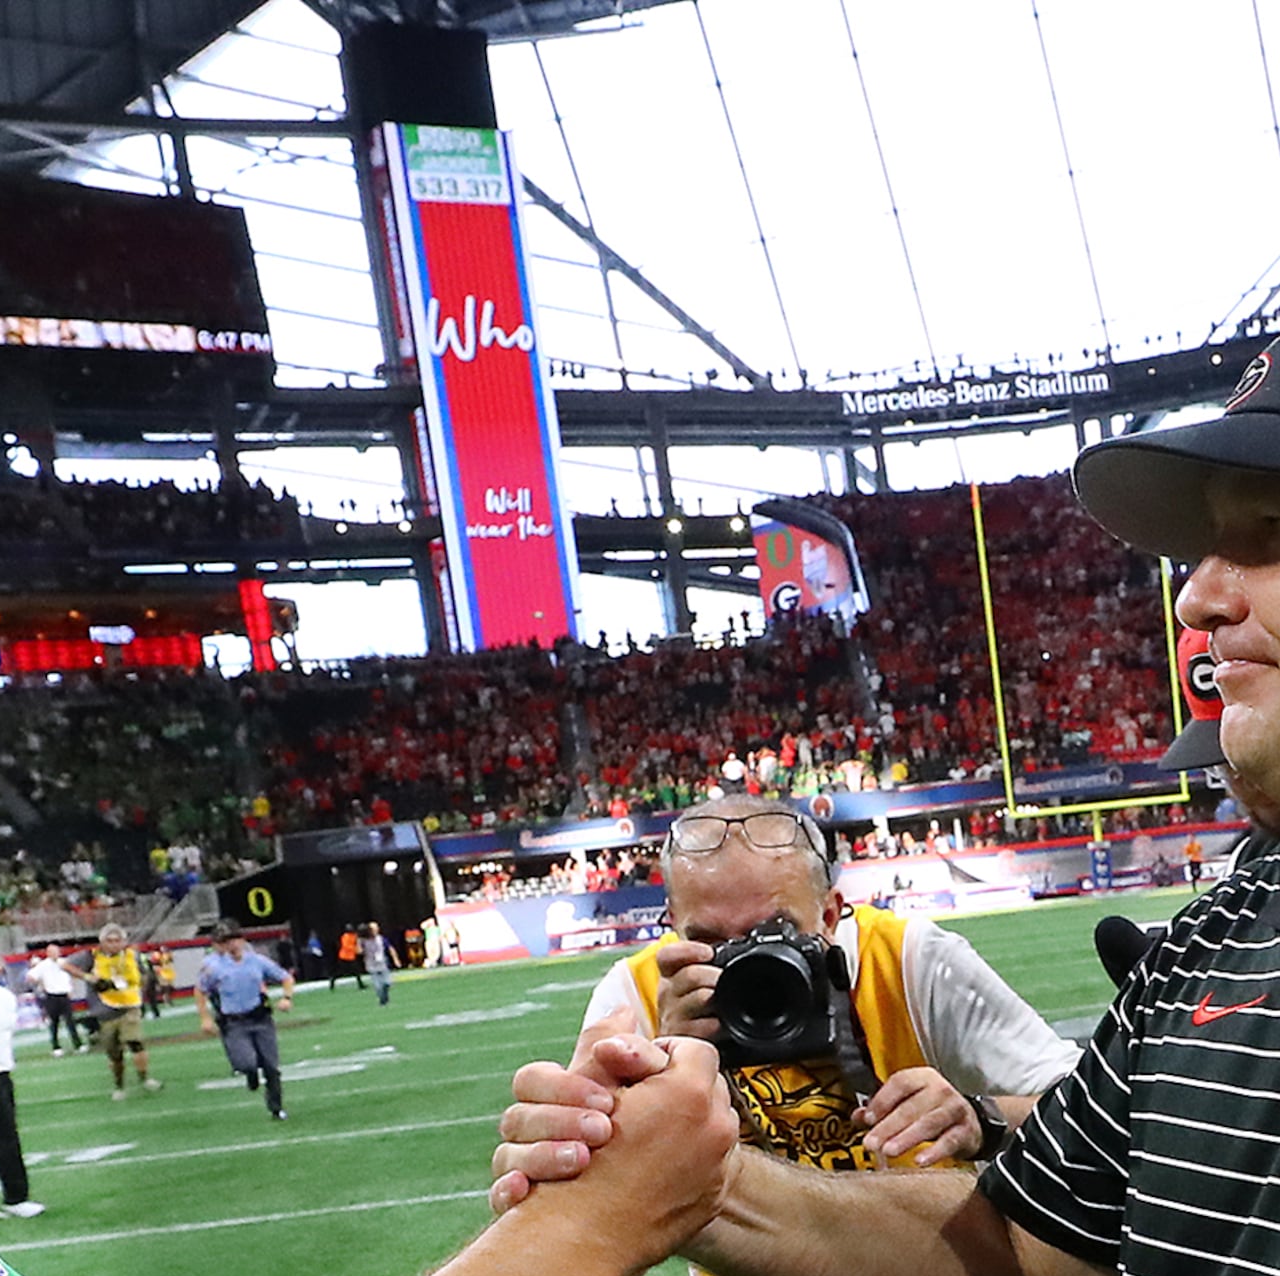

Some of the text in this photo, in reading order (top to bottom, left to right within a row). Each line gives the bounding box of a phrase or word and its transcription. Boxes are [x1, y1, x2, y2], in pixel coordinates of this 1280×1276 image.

[427, 295, 534, 361] Who
[240, 332, 271, 352] PM
[842, 372, 1110, 415] Mercedes-Benz Stadium
[485, 488, 531, 514] Will
[465, 524, 513, 538] wear
